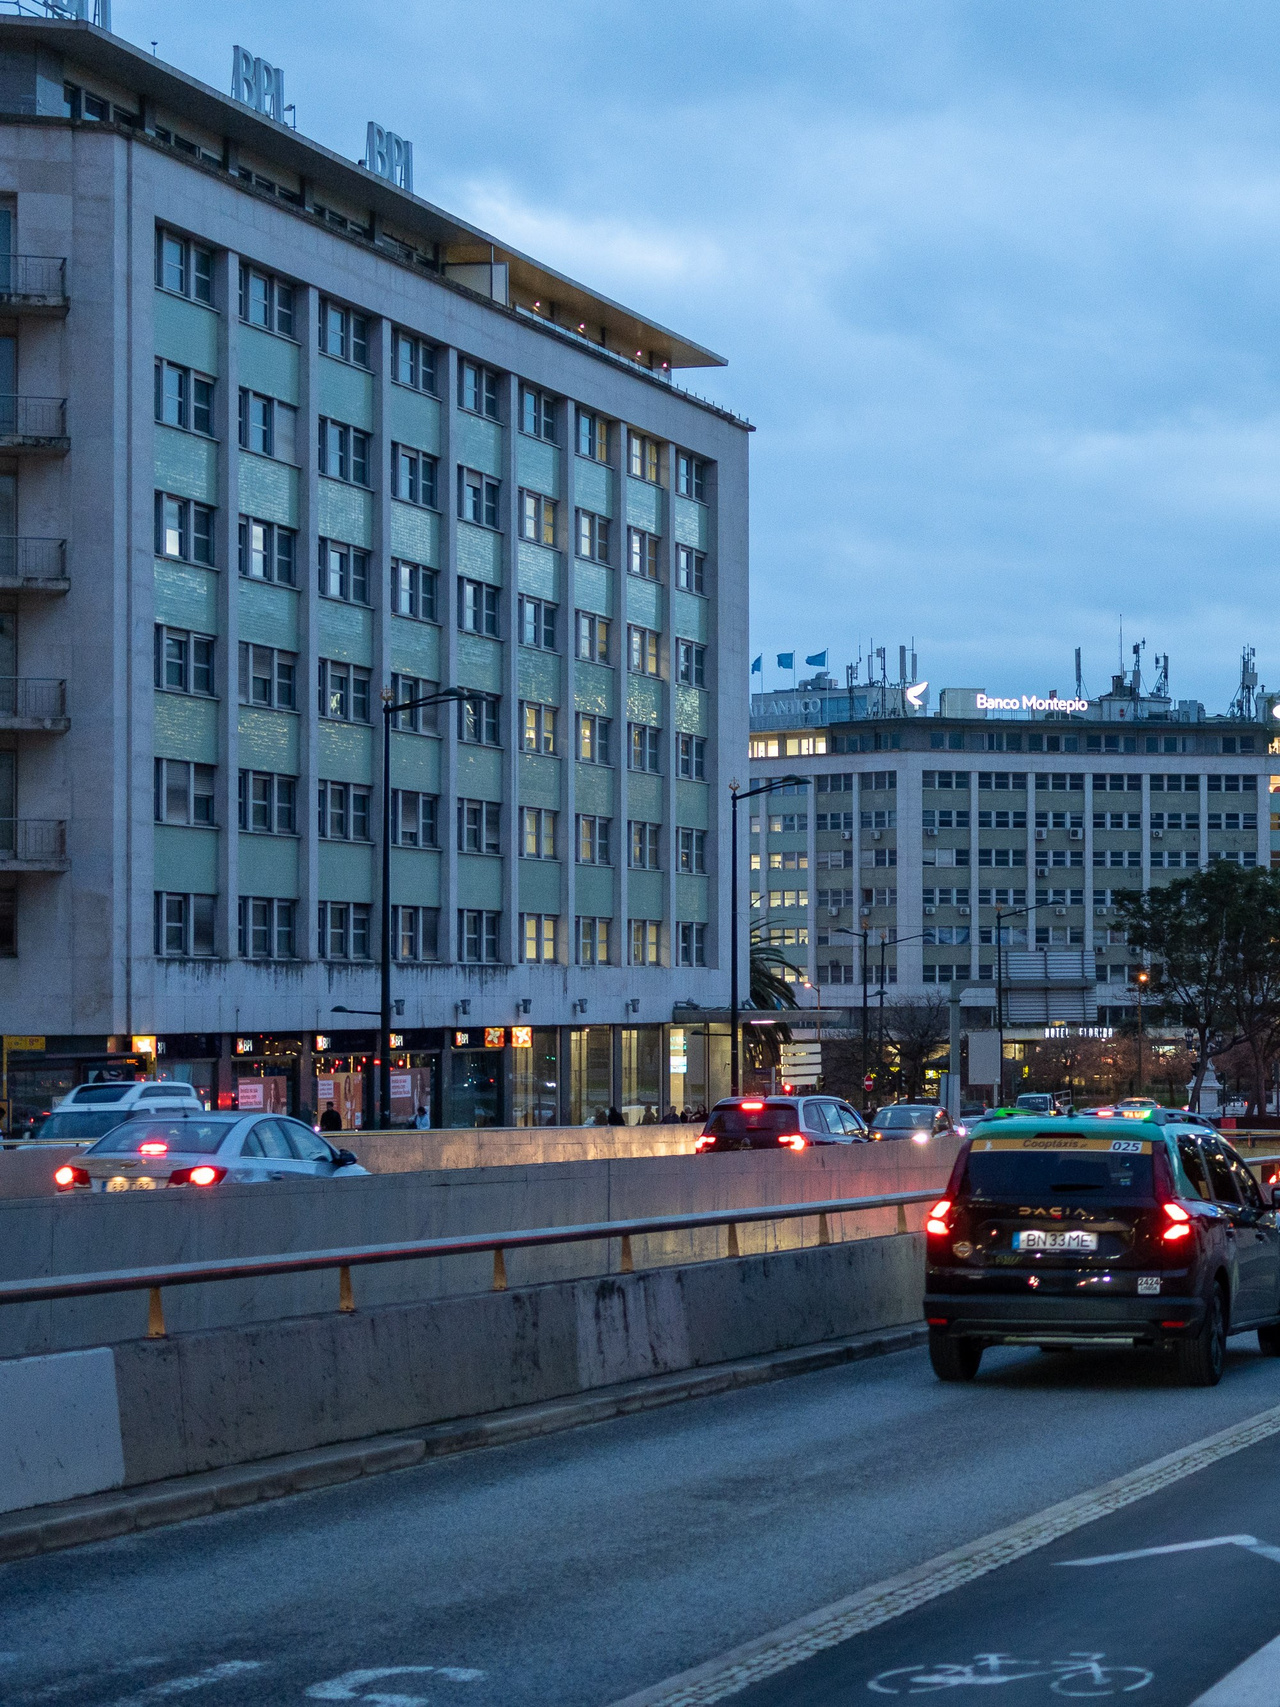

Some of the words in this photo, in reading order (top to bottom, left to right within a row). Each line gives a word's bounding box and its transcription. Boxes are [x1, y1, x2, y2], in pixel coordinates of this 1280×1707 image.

[232, 45, 285, 123] BPI
[367, 121, 413, 193] BPI
[976, 694, 1020, 709] Banco
[1021, 695, 1088, 714] Montepio
[1044, 1028, 1070, 1039] HOTEL
[1079, 1028, 1113, 1038] FLORIDA
[243, 1040, 253, 1052] BPI
[395, 1035, 404, 1047] BPI
[1112, 1141, 1141, 1151] 025
[1018, 1206, 1088, 1216] DACIA
